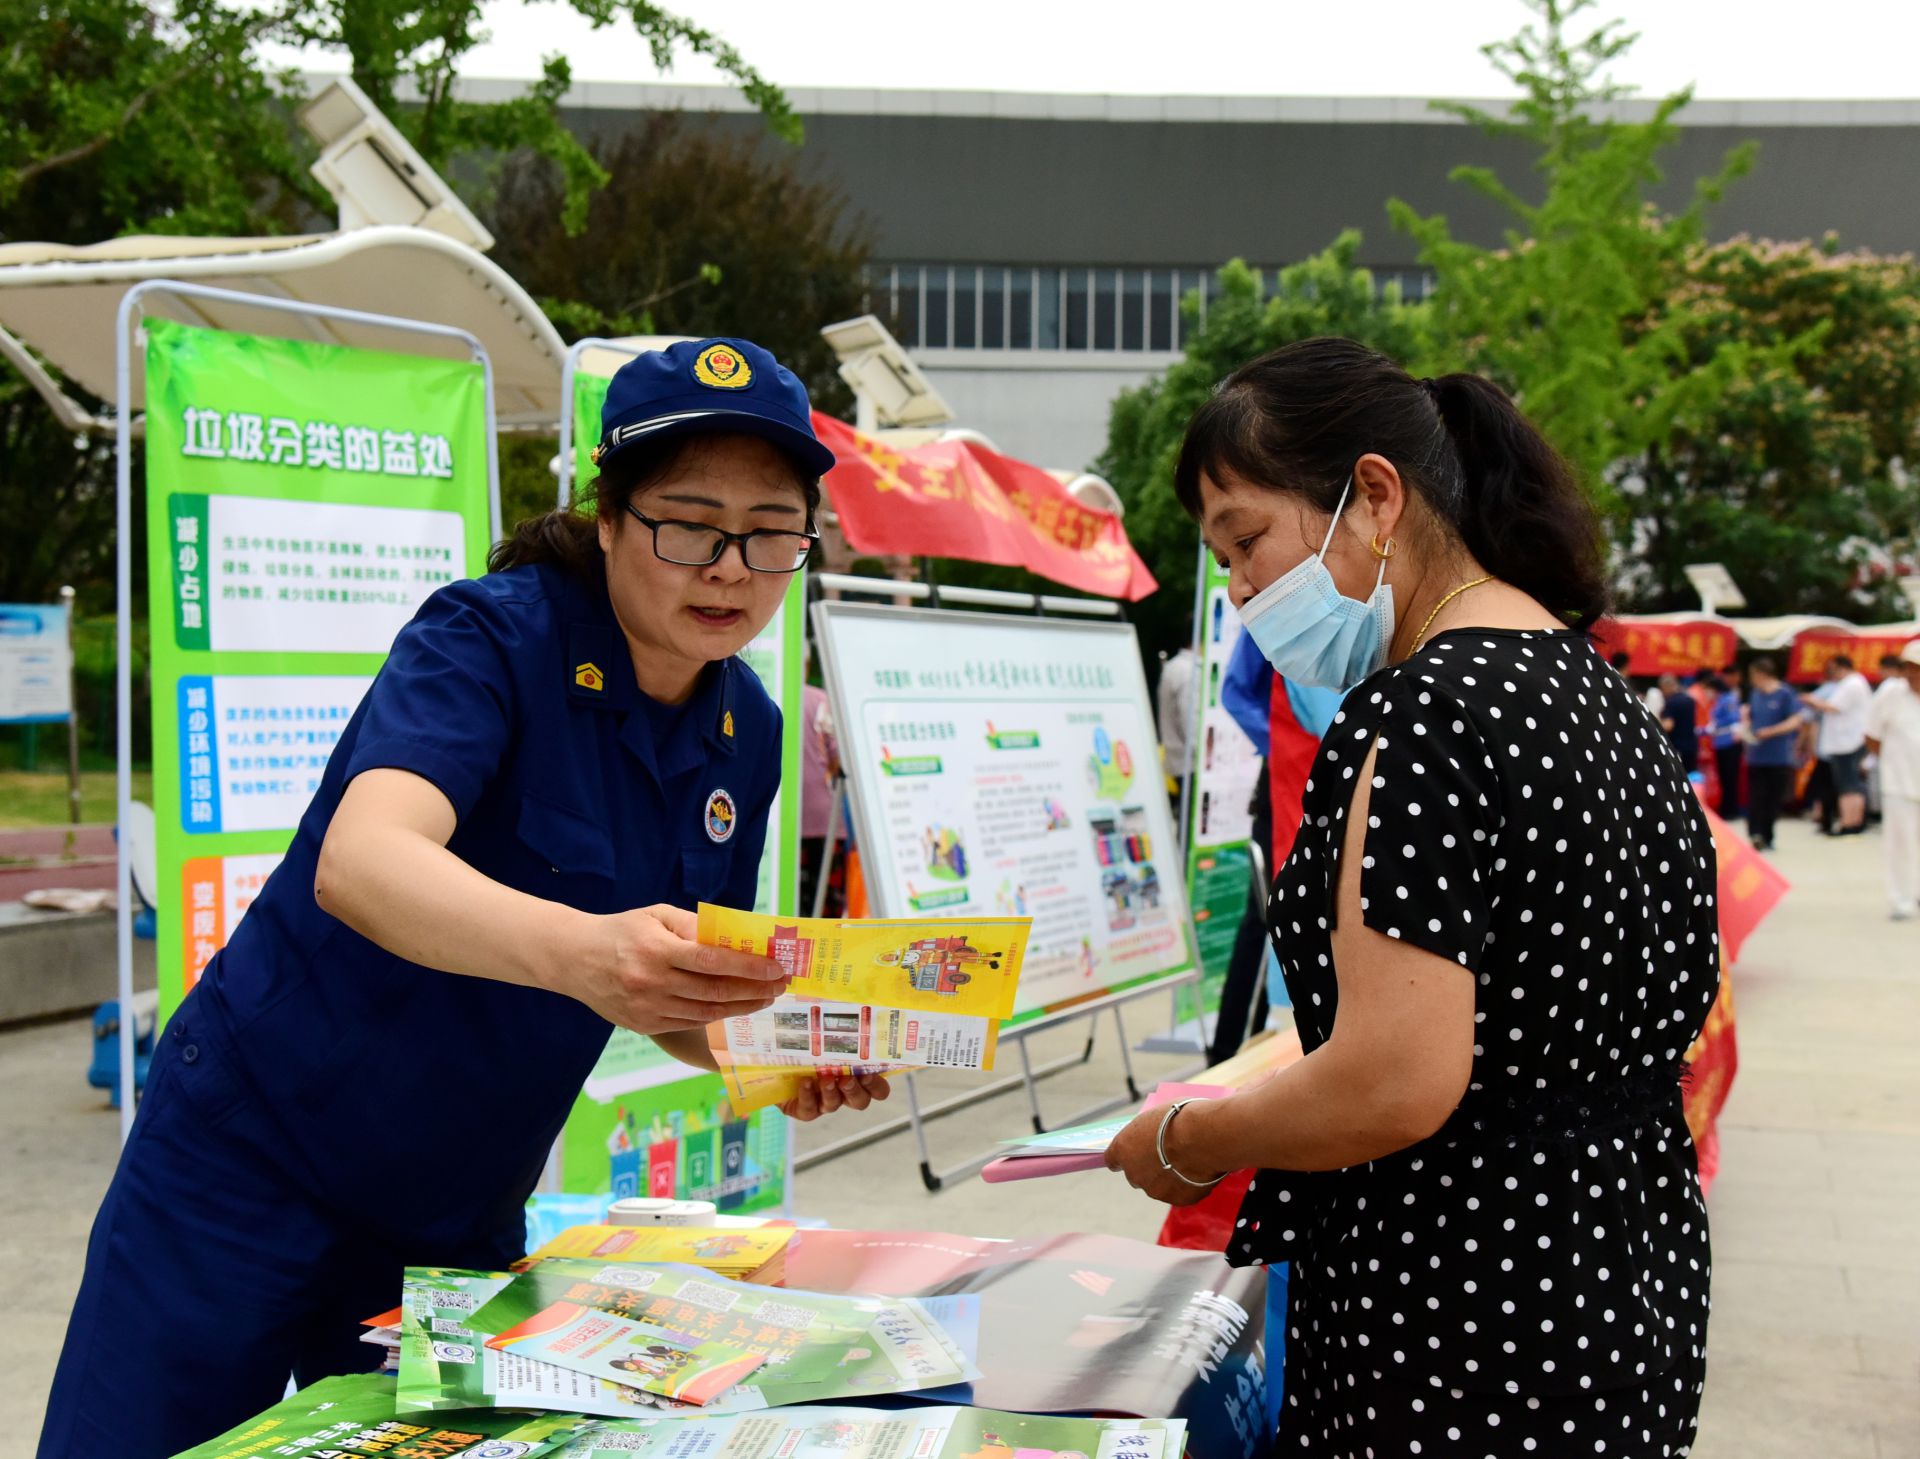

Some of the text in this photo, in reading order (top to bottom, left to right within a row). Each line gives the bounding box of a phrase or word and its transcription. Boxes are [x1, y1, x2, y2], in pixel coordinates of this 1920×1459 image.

[181, 407, 454, 478] 垃圾分类的益处
[192, 881, 216, 980] 变废为
[272, 1421, 363, 1456] 三清三关
